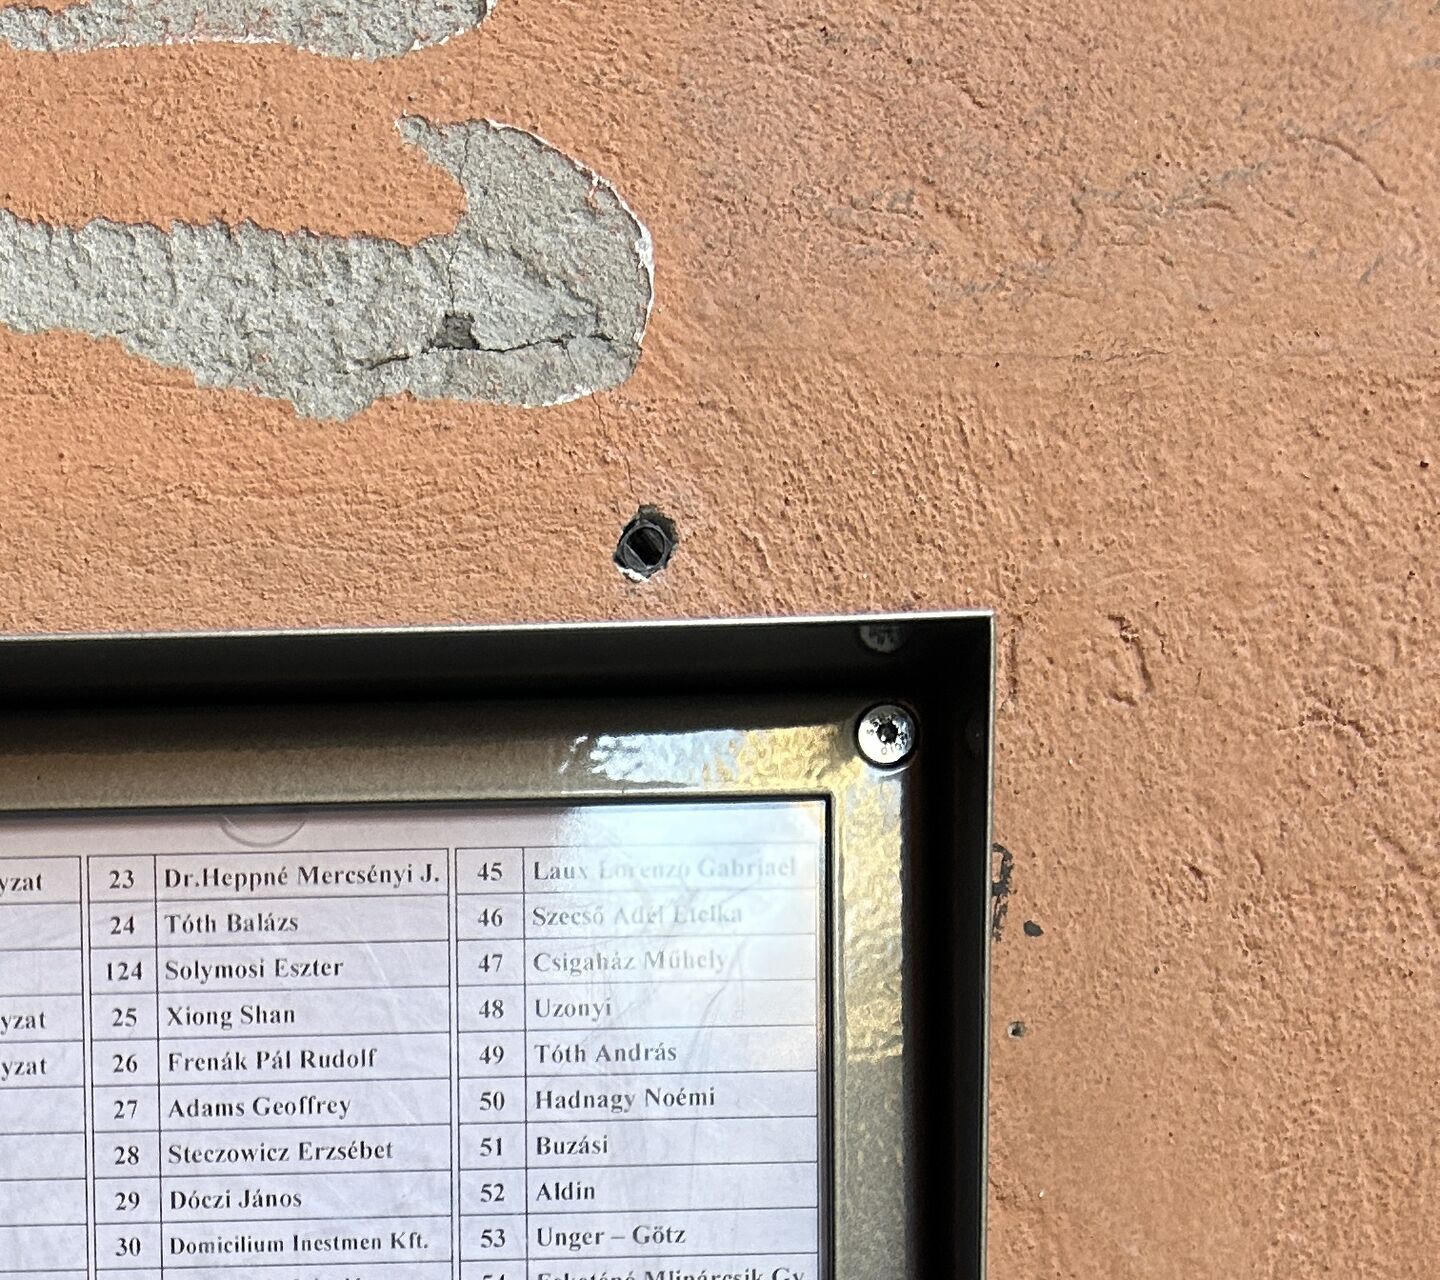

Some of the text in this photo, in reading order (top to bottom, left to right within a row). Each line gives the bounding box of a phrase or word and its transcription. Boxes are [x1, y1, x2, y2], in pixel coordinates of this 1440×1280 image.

[109, 869, 135, 890] 23
[420, 863, 440, 883] J.
[110, 912, 298, 935] 24 Tóth Balázs
[478, 997, 611, 1023] 48 Uzonyi
[479, 1042, 677, 1065] 49 Tóth András
[113, 1095, 350, 1120] 27 Adams Geoffrey
[479, 1086, 715, 1114] 50 Hadnagy Noémi
[114, 1145, 140, 1166] 28
[298, 1140, 392, 1161] Erzsébet
[114, 1188, 302, 1211] 29 Dóczi János
